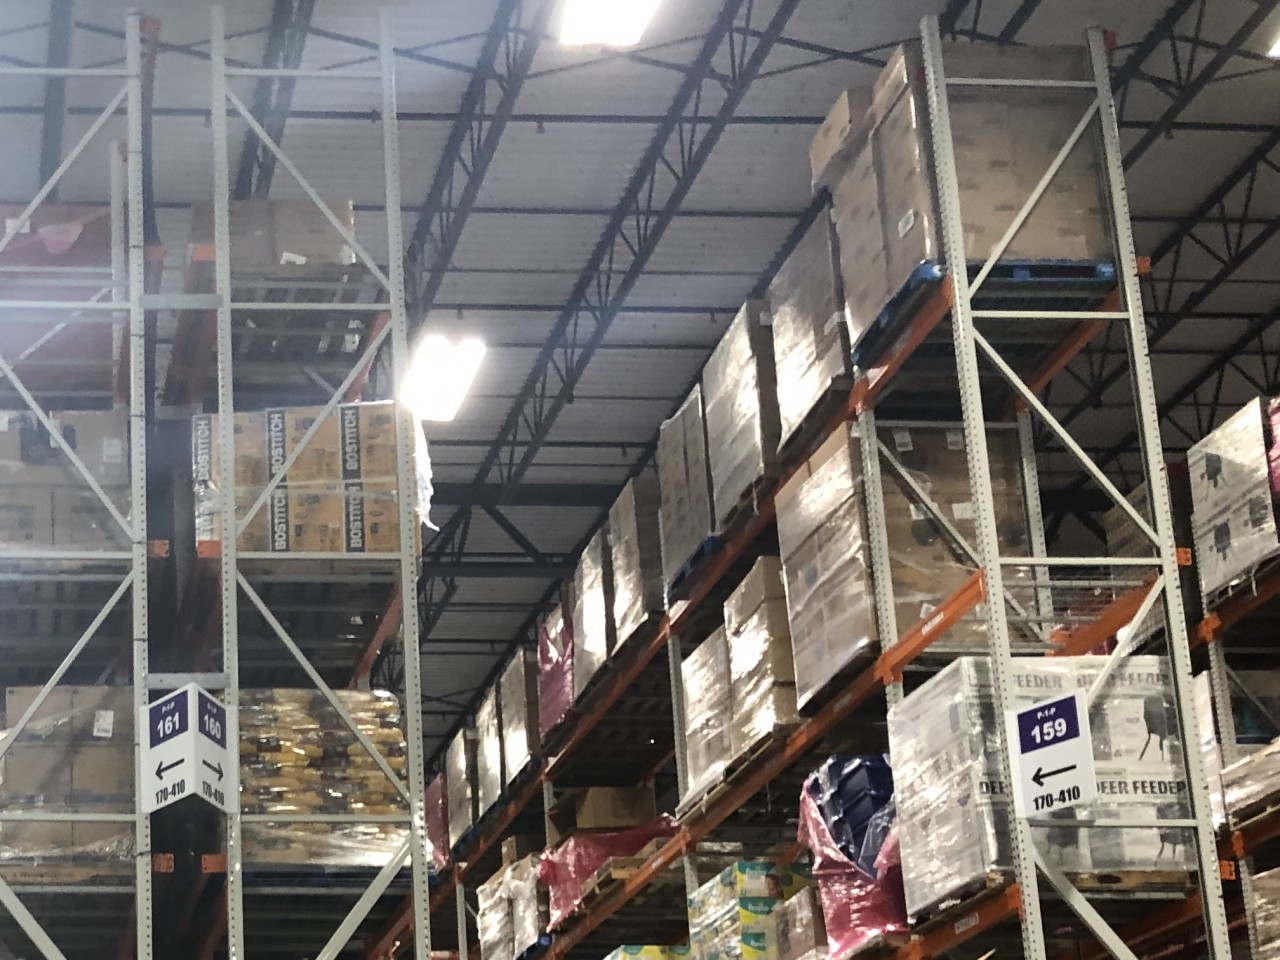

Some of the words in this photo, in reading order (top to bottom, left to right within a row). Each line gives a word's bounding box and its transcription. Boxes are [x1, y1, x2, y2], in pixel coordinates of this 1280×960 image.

[270, 413, 283, 474] BOSTITCH
[345, 410, 358, 470] BOSTITCH
[157, 712, 180, 738] 161
[1037, 707, 1057, 720] P-1-P
[203, 714, 222, 740] 160
[1030, 718, 1068, 744] 159
[155, 779, 186, 806] 170-410
[202, 781, 225, 806] 170-410
[1033, 785, 1081, 811] 170-410
